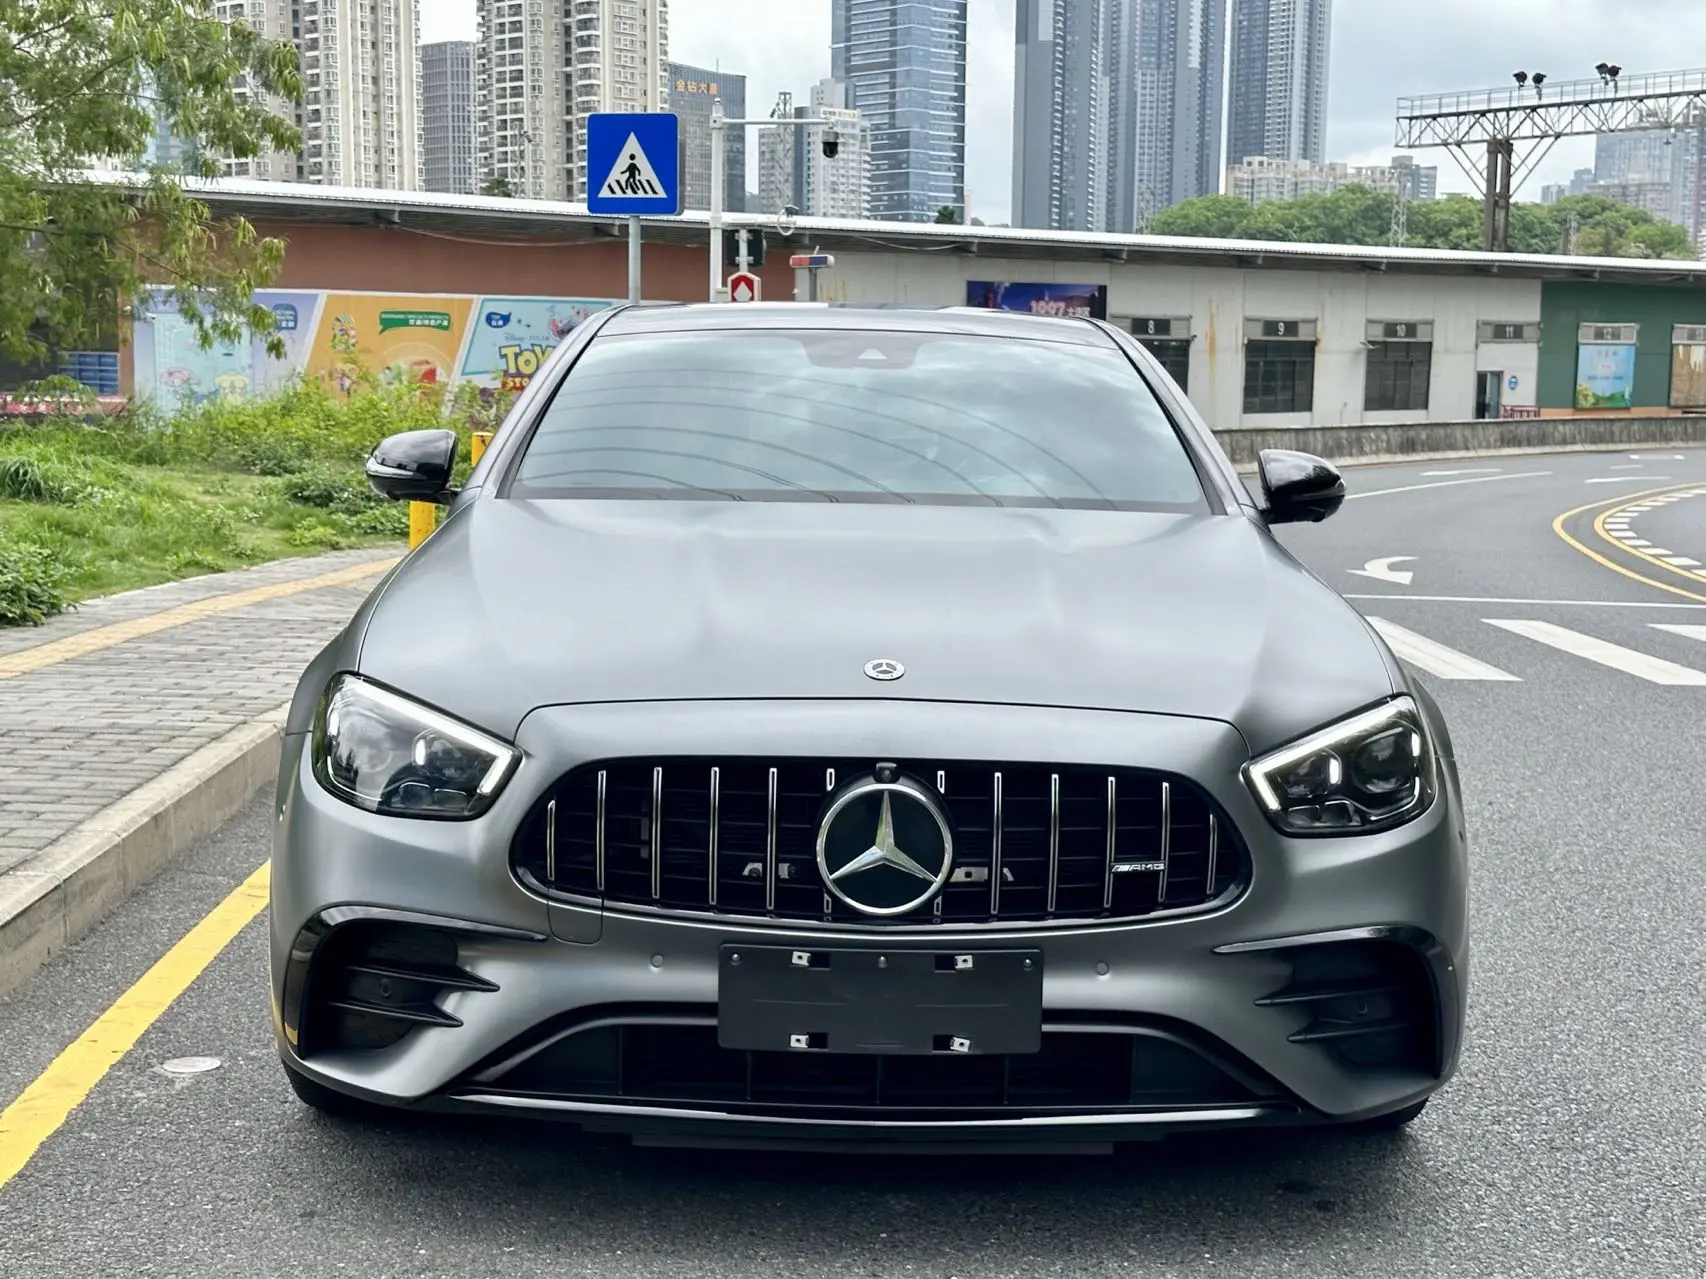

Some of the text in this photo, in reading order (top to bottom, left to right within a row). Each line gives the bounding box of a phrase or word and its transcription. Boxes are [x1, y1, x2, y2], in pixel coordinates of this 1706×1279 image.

[1147, 320, 1155, 334] 8
[1277, 322, 1285, 335] 9
[1396, 324, 1406, 337] 10
[1505, 326, 1514, 338] 11
